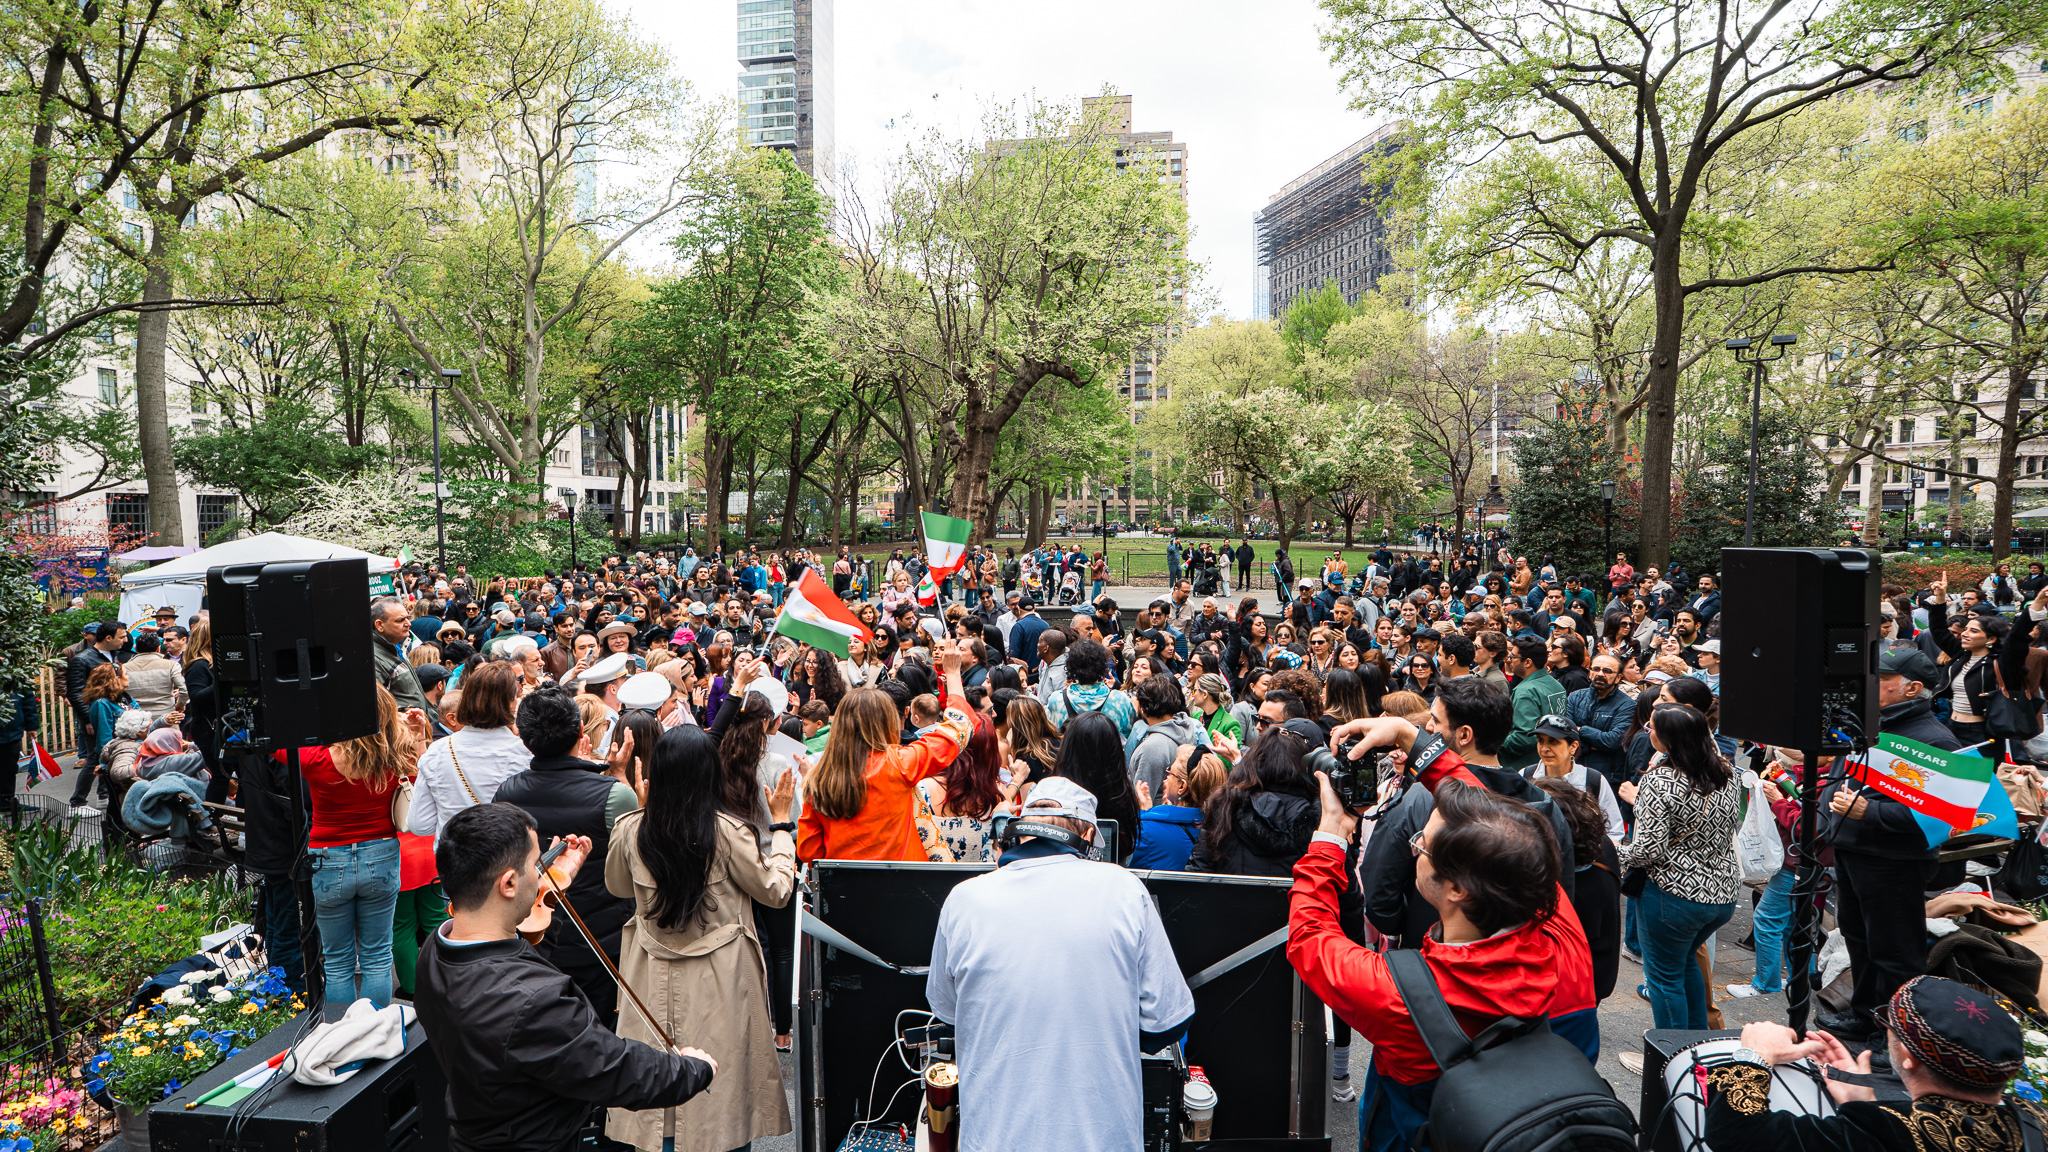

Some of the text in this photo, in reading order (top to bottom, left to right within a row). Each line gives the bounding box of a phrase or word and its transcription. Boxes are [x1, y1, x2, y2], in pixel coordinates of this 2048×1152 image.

[1414, 738, 1445, 768] SONY
[1889, 741, 1948, 767] 100 YEARS
[1879, 780, 1924, 806] PAHLAVI
[1015, 824, 1063, 837] audio-technica
